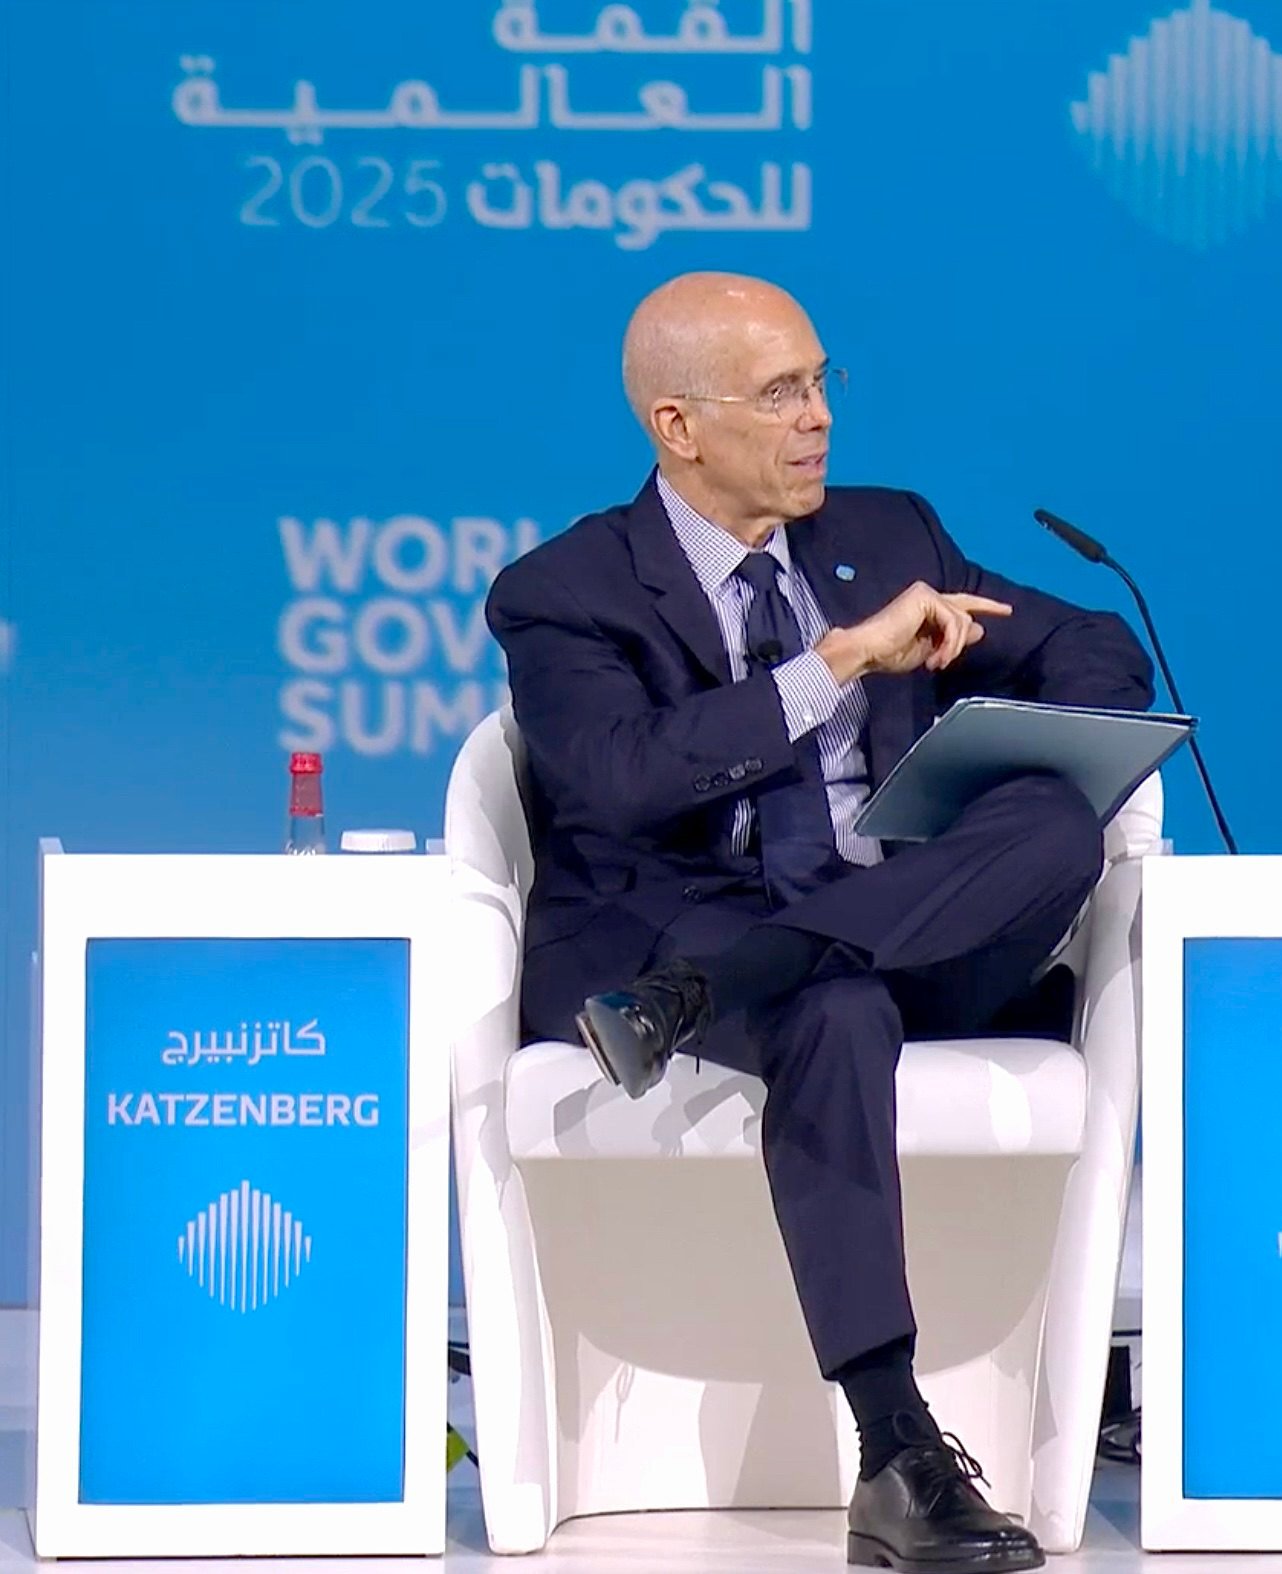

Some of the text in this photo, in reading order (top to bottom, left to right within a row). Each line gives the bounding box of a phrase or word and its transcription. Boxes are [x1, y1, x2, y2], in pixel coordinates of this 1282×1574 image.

[173, 55, 812, 145] العالمية
[239, 156, 812, 251] للحكومات 2025
[161, 1018, 327, 1066] كاتزنبيرج
[106, 1092, 380, 1127] KATZENBERG
